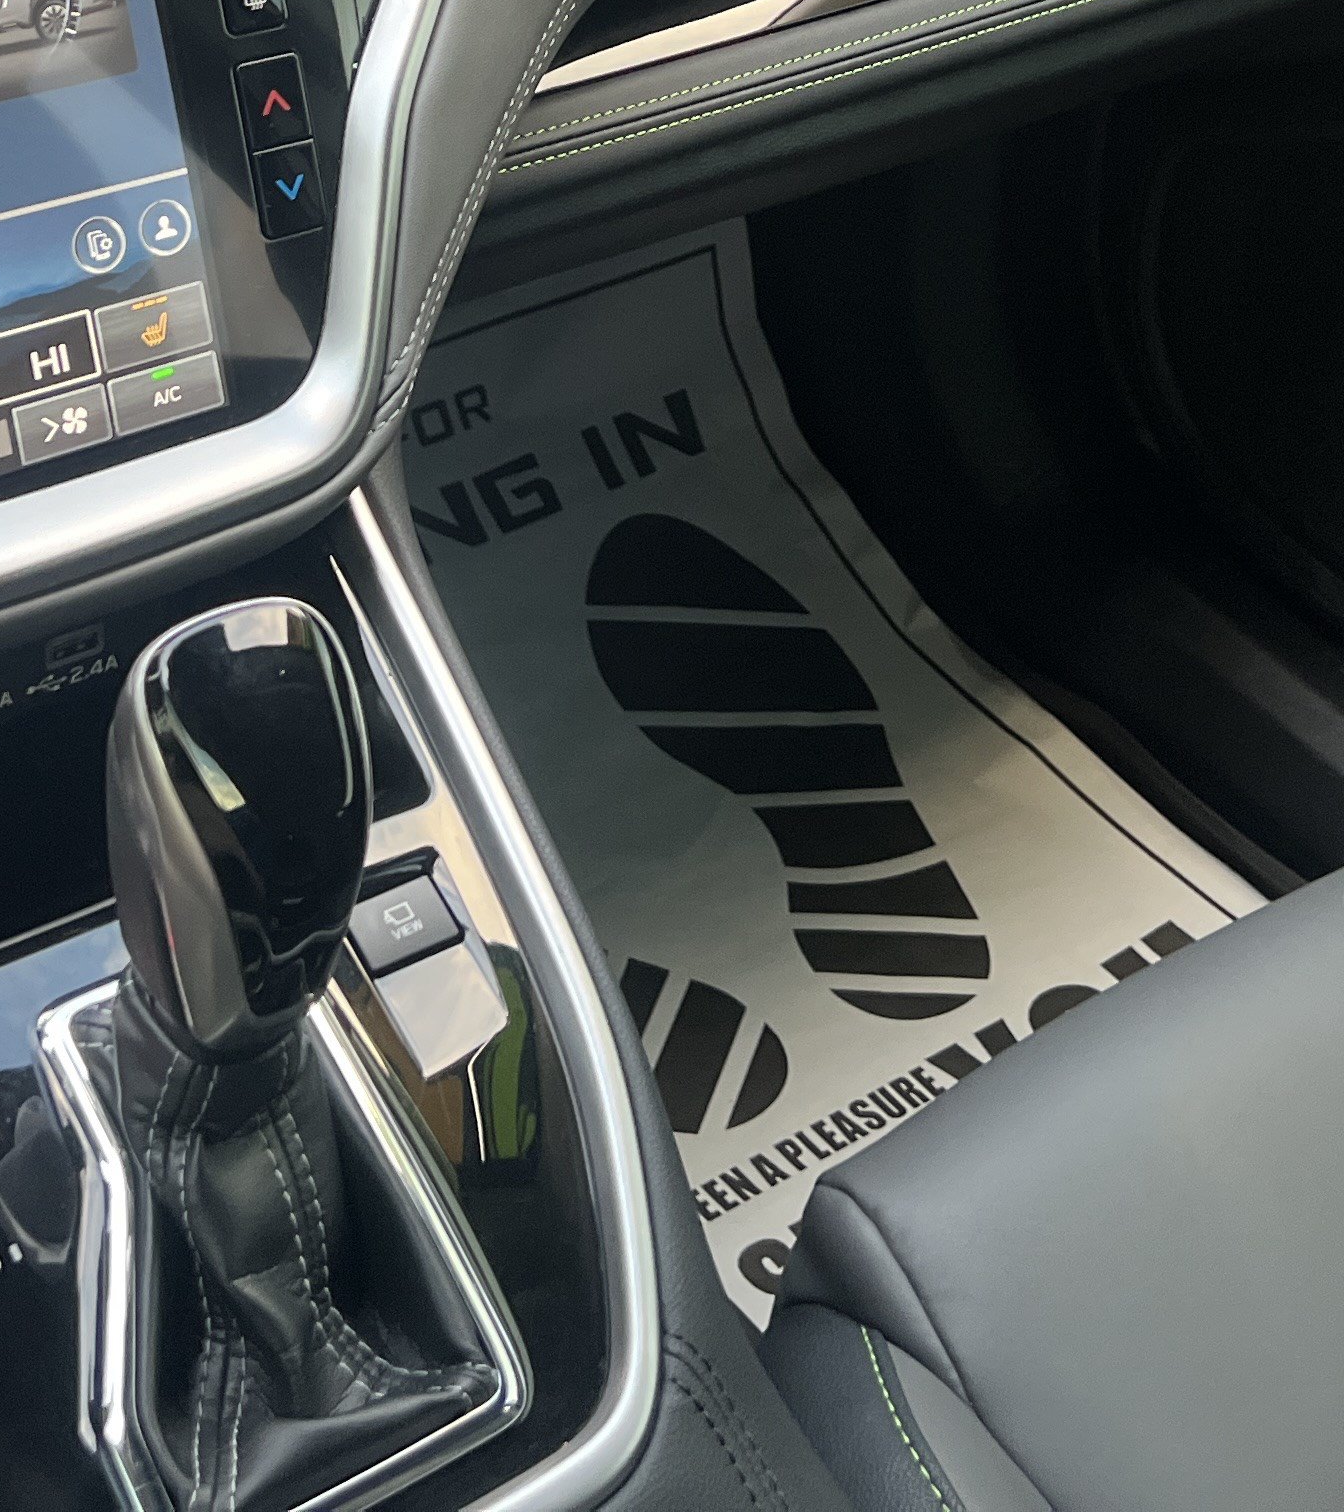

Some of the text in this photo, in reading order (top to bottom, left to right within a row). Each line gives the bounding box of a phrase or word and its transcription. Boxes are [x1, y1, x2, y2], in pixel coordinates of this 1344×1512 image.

[29, 343, 71, 381] HI
[152, 384, 182, 408] A/C
[581, 387, 707, 491] IN
[69, 654, 120, 685] 2.4A
[390, 918, 424, 941] VIEW
[749, 1153, 791, 1187] A
[774, 1065, 947, 1172] PLEASURE
